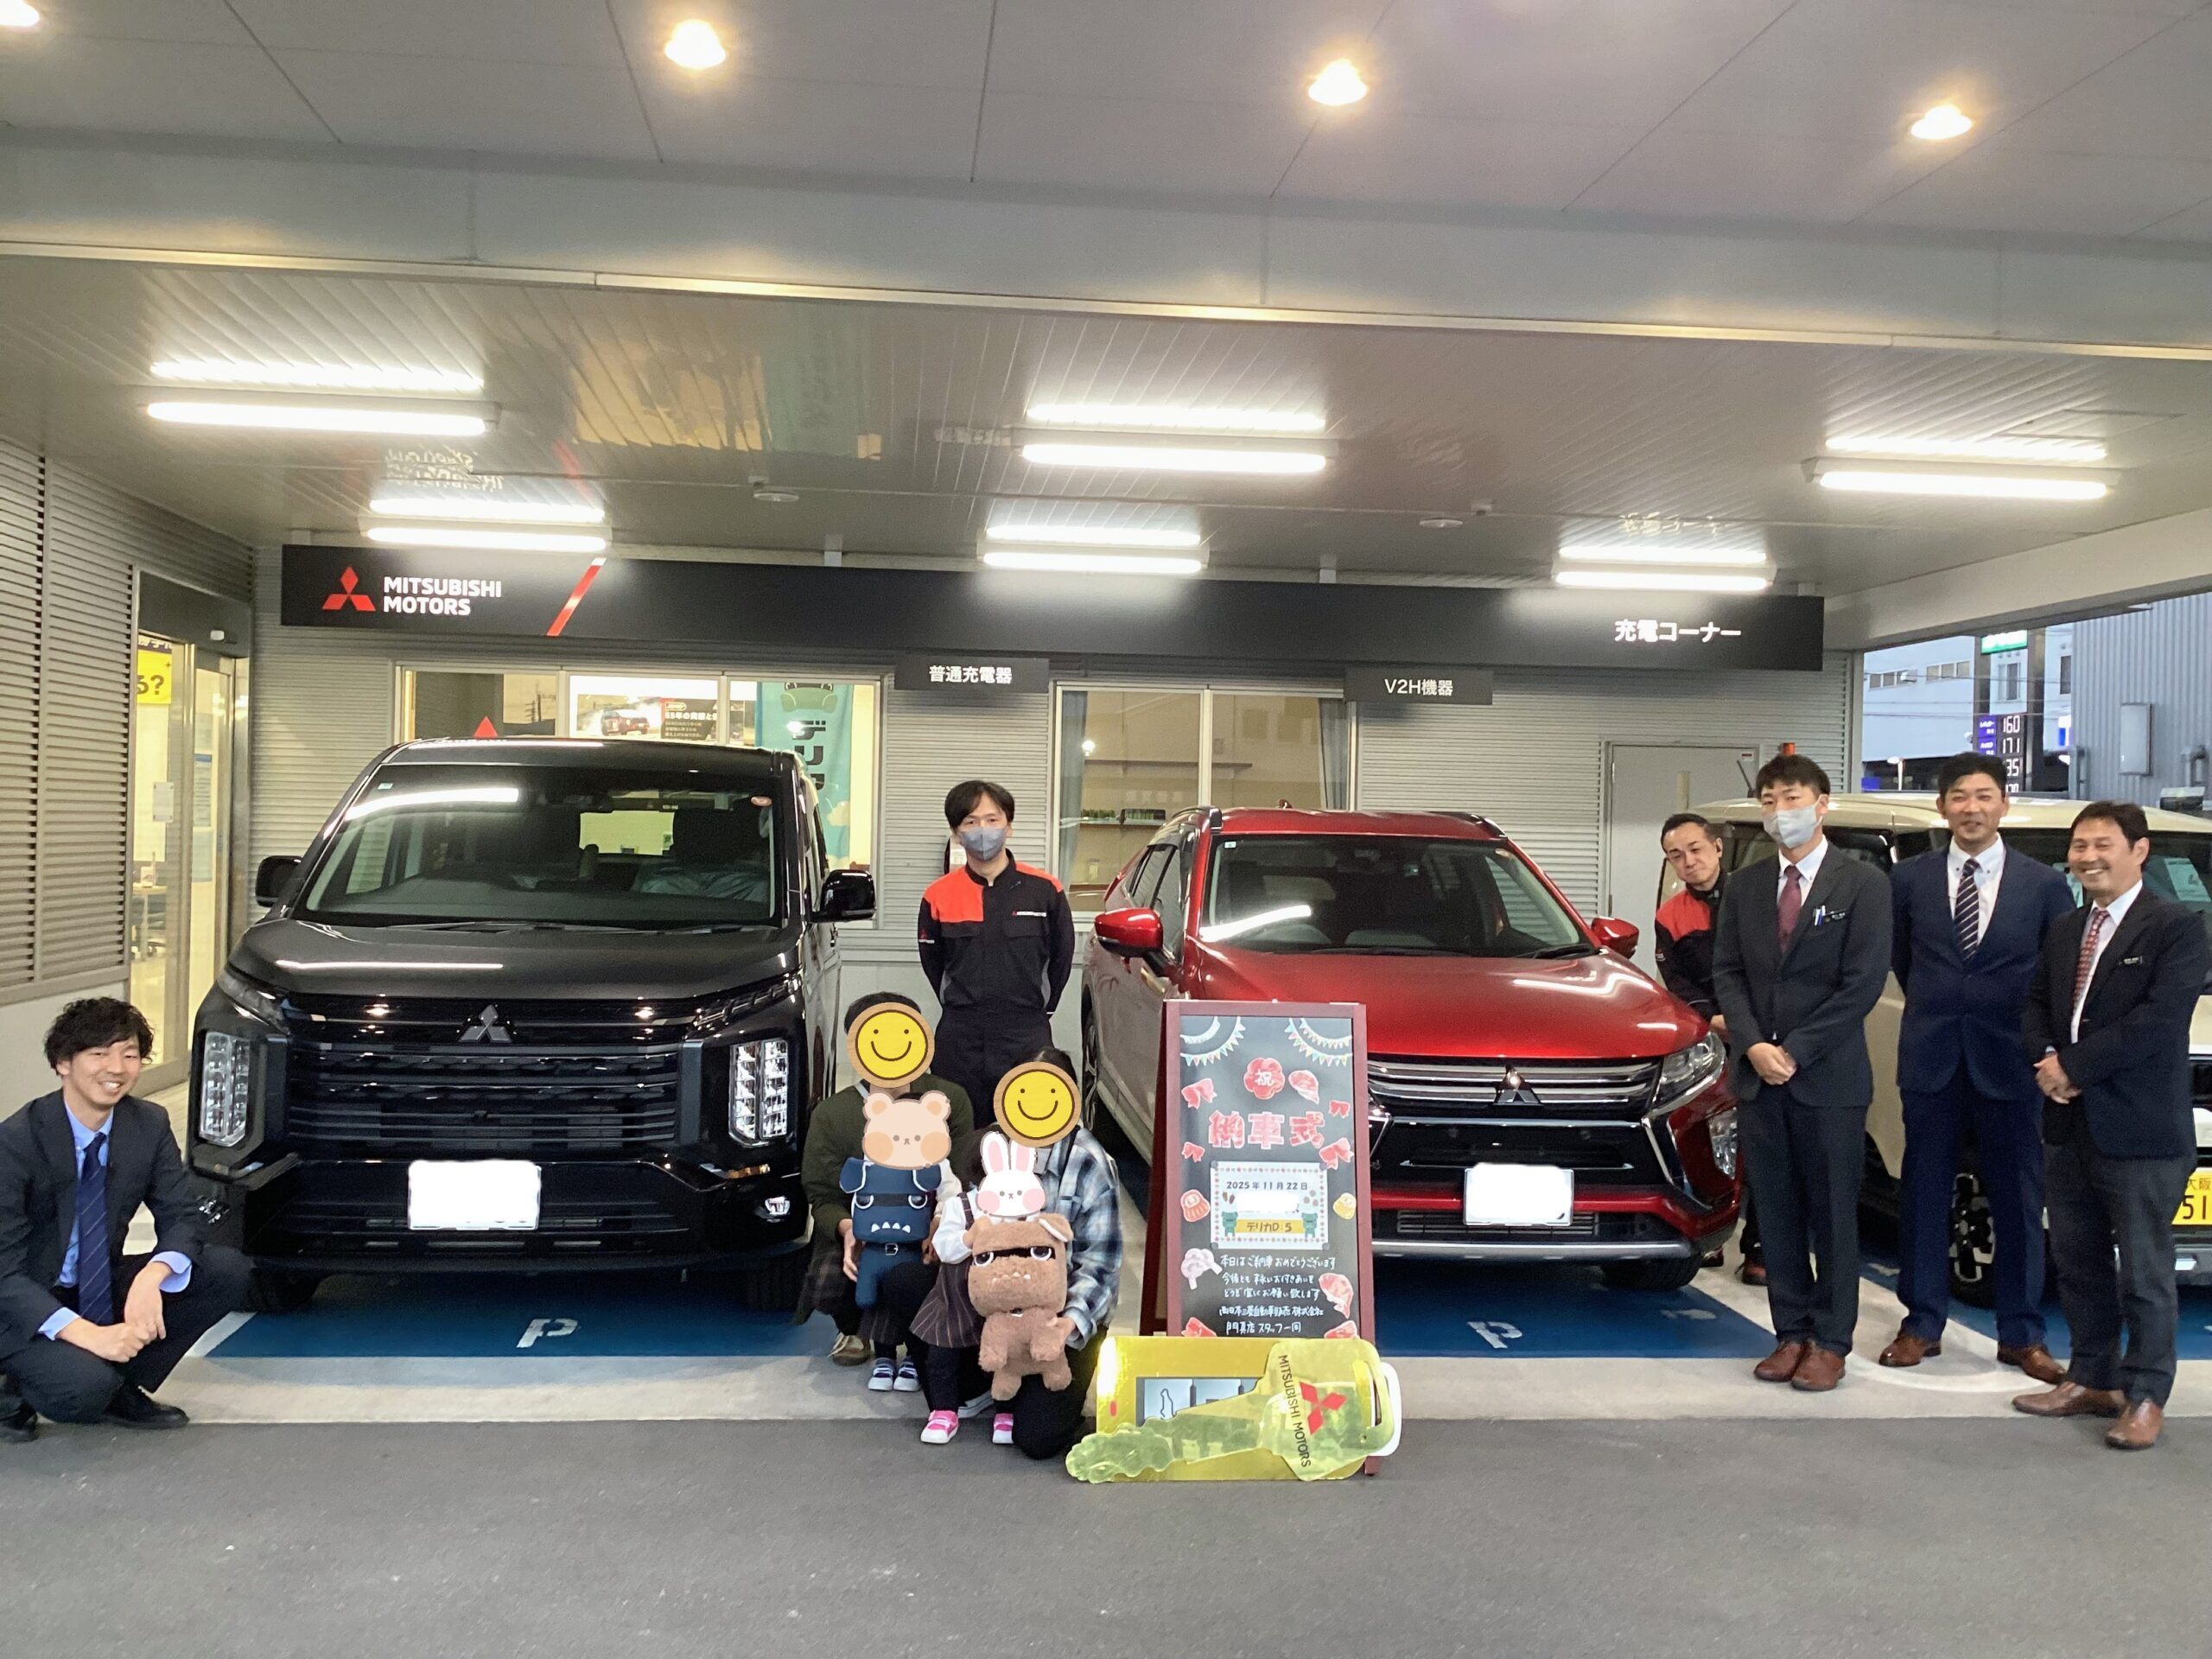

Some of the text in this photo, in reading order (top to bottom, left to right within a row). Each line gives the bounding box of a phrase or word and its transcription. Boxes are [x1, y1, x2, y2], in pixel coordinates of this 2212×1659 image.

[384, 576, 502, 598] MITSUBISHI
[384, 596, 471, 616] MOTORS
[1614, 619, 1742, 643] 充電コーナー
[929, 665, 1013, 684] 普通充電器
[1384, 678, 1453, 696] V2H機器
[2003, 715, 2020, 734] 160
[2002, 737, 2020, 754] 171
[2005, 758, 2019, 777] 35
[1255, 1069, 1273, 1086] 祝
[1208, 1109, 1325, 1150] 納車式
[1226, 1181, 1308, 1191] 2025年11月22日
[2183, 1195, 2207, 1220] 51
[516, 1318, 579, 1348] P
[1466, 1321, 1523, 1349] P
[1278, 1354, 1313, 1467] MITSUBISHI MOTORS
